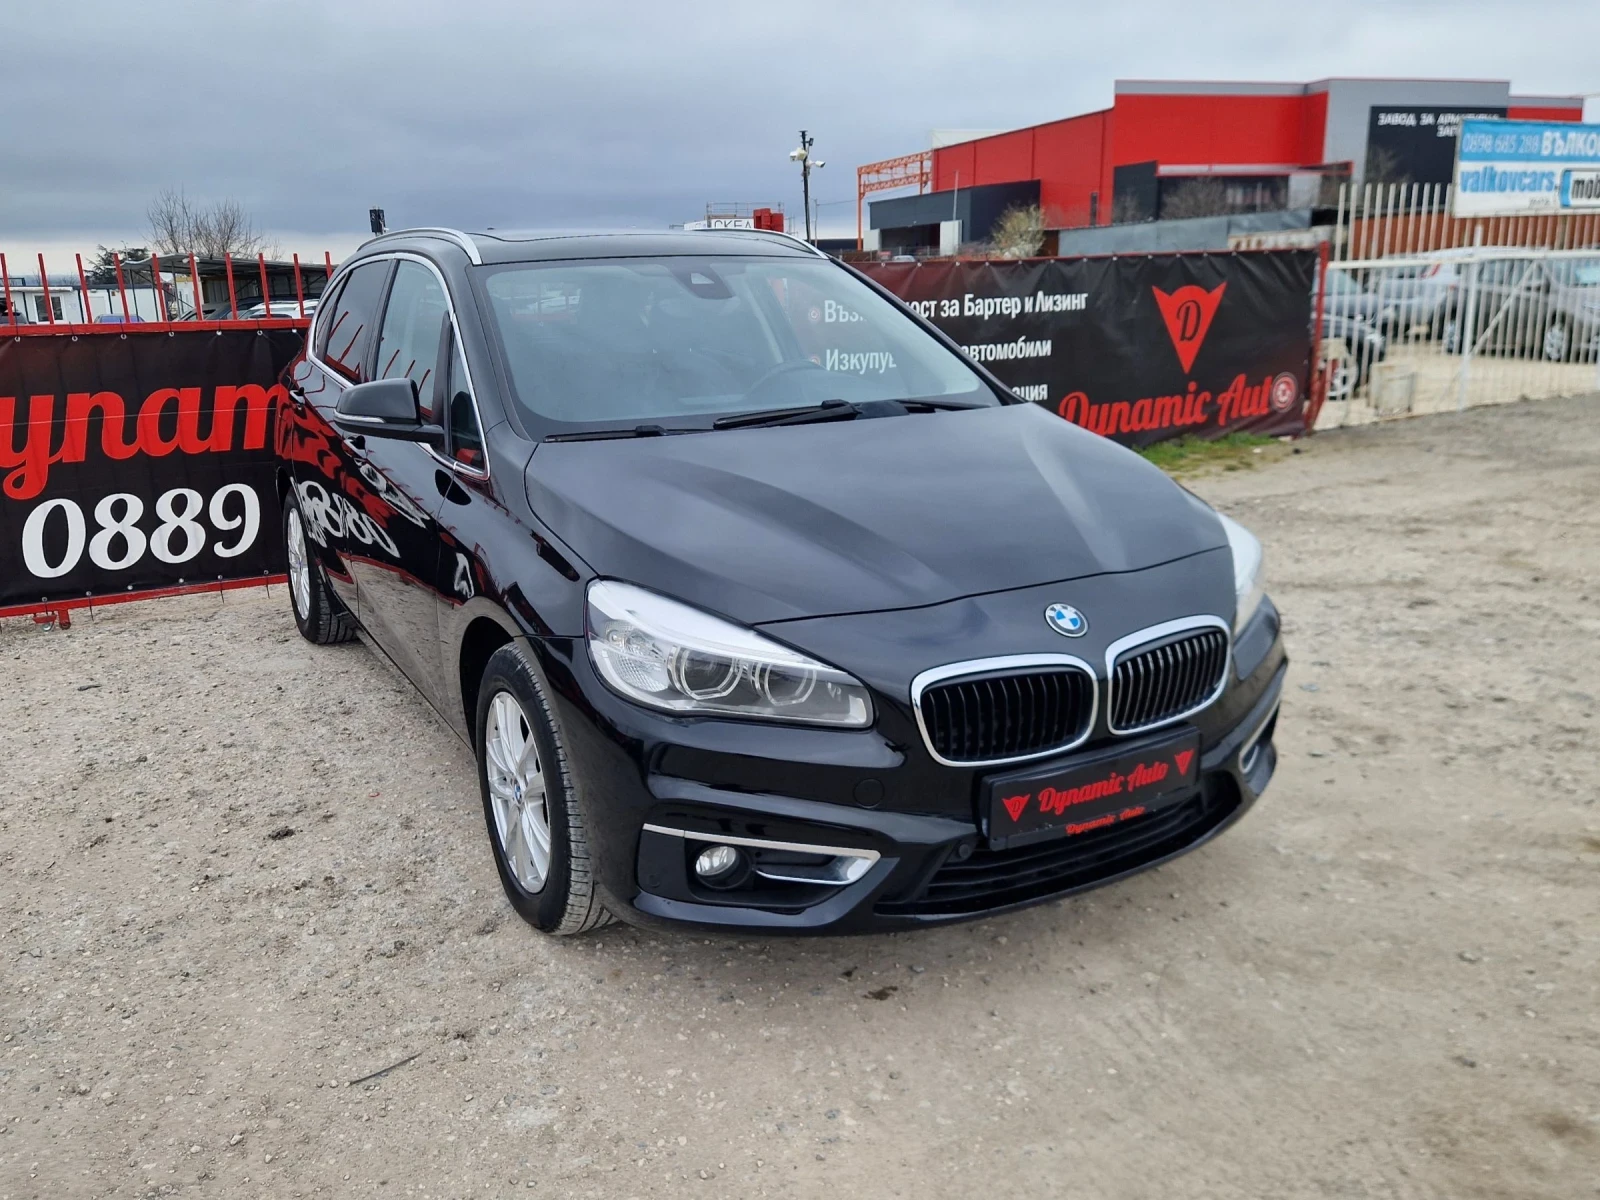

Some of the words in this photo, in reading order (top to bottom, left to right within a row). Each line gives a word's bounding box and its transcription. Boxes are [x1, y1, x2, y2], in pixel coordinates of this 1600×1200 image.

[1540, 130, 1600, 157] ВЪЛКО
[939, 298, 960, 318] за
[963, 293, 1022, 321] Бартер
[1034, 290, 1088, 313] Лизинг
[1058, 381, 1212, 437] Dynamic
[0, 383, 288, 500] ynam
[22, 483, 261, 578] 0889
[1037, 772, 1125, 815] Dynamic
[1127, 761, 1169, 792] Auto
[1065, 814, 1115, 835] Dynamic
